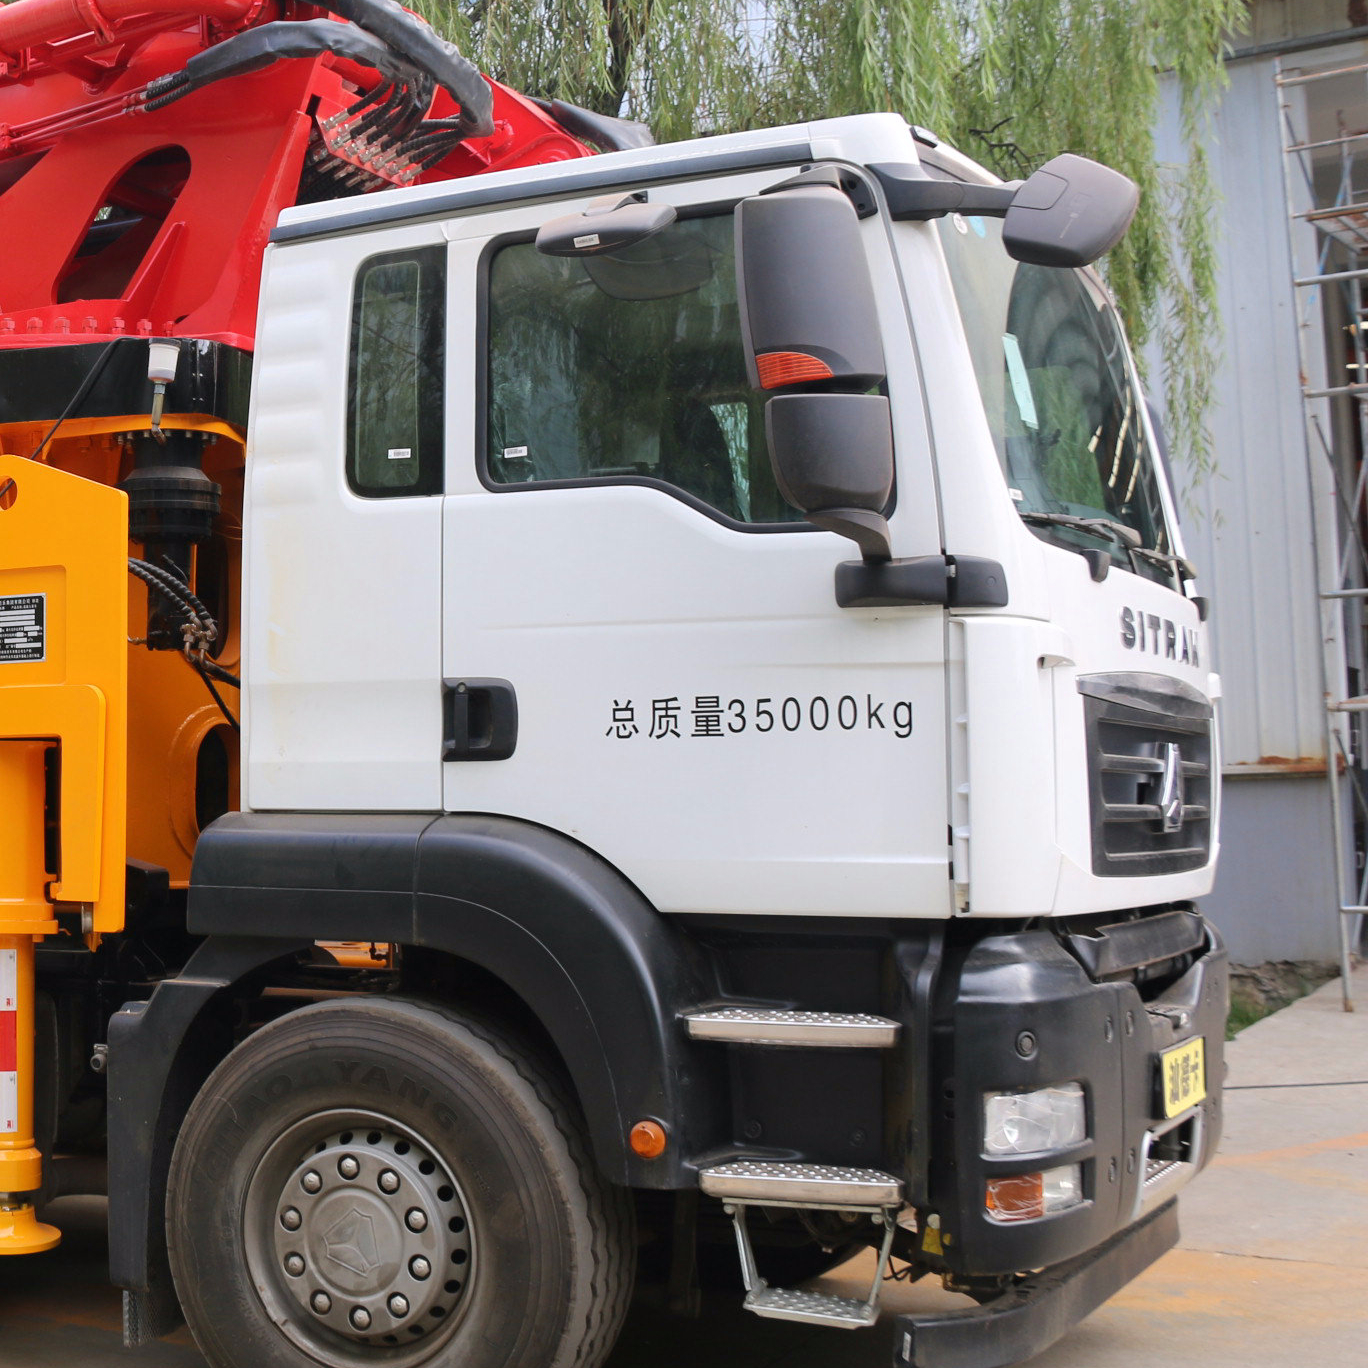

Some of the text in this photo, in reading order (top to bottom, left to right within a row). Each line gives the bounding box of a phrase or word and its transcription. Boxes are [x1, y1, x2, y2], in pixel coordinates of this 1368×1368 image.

[605, 694, 913, 739] 总质量35000kg
[332, 1059, 459, 1132] YANG
